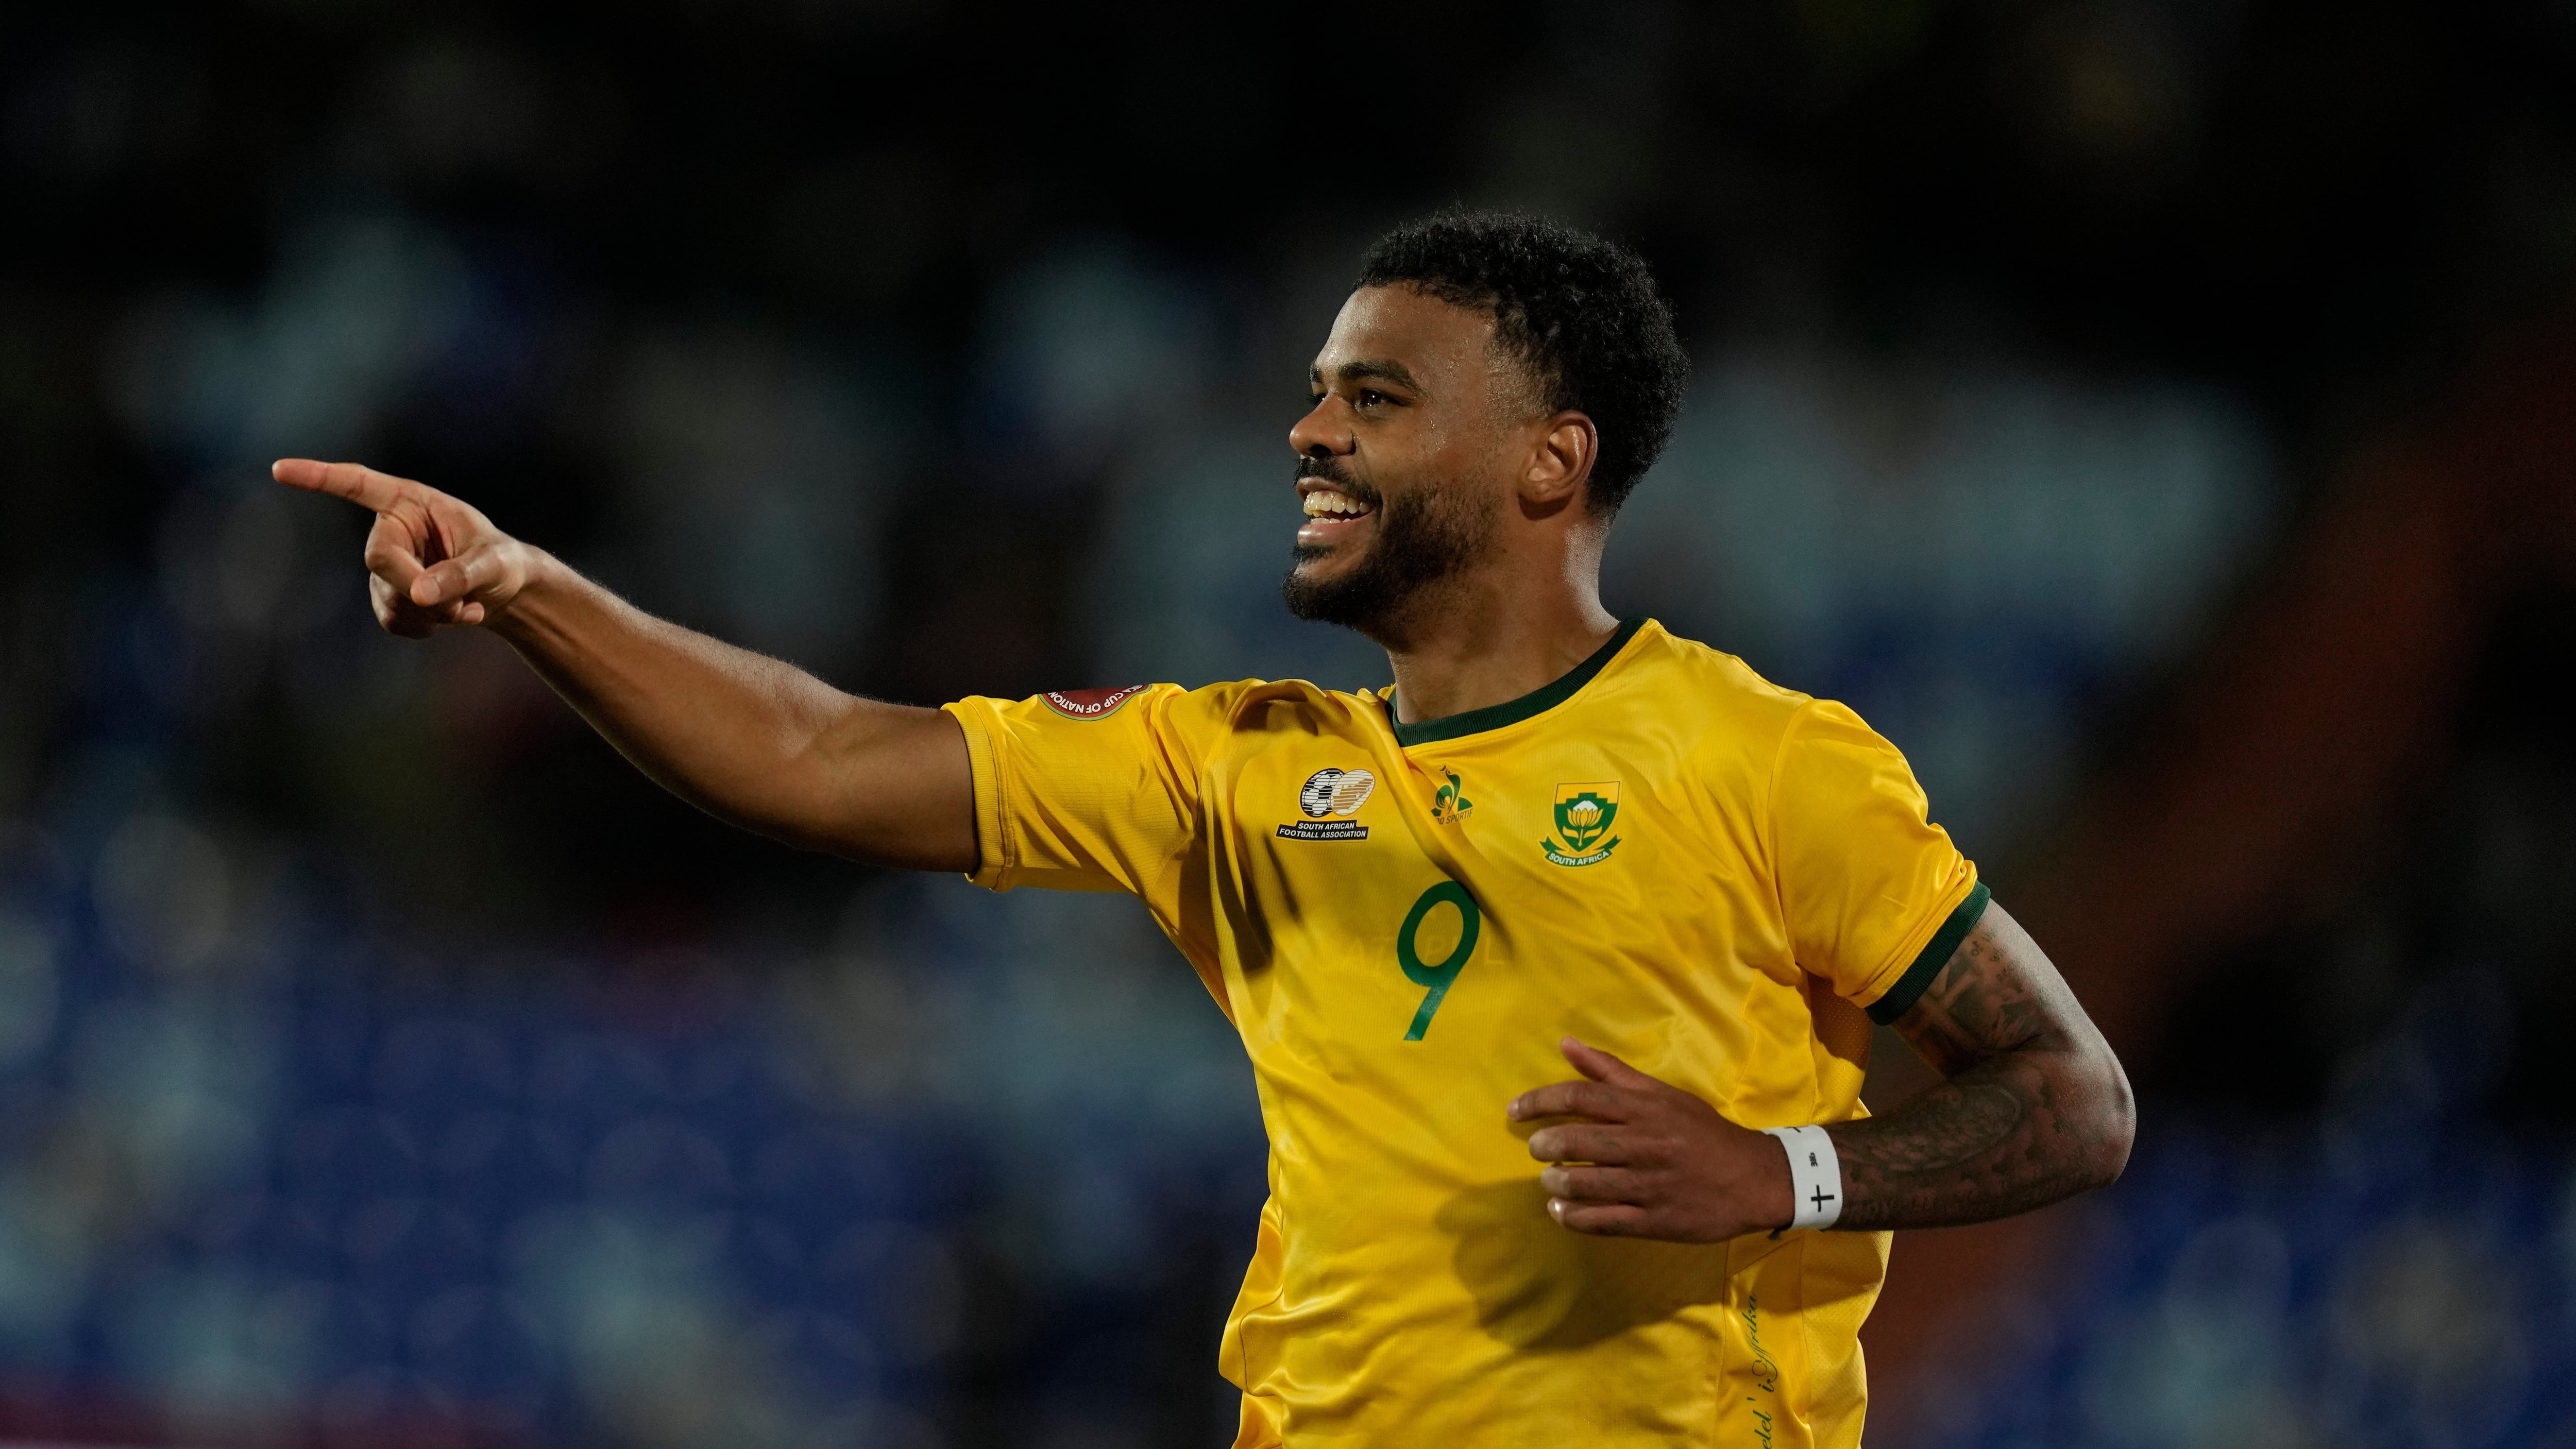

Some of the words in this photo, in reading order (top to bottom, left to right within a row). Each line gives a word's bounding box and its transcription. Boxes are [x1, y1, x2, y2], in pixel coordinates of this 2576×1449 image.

[1104, 692, 1124, 708] CUP
[1086, 703, 1101, 713] OF
[1279, 828, 1319, 838] FOOTBALL
[1320, 830, 1366, 839] ASSOCIATION
[1548, 853, 1576, 865] SOUTH
[1577, 851, 1609, 865] AFRICA
[1397, 880, 1480, 1041] 9
